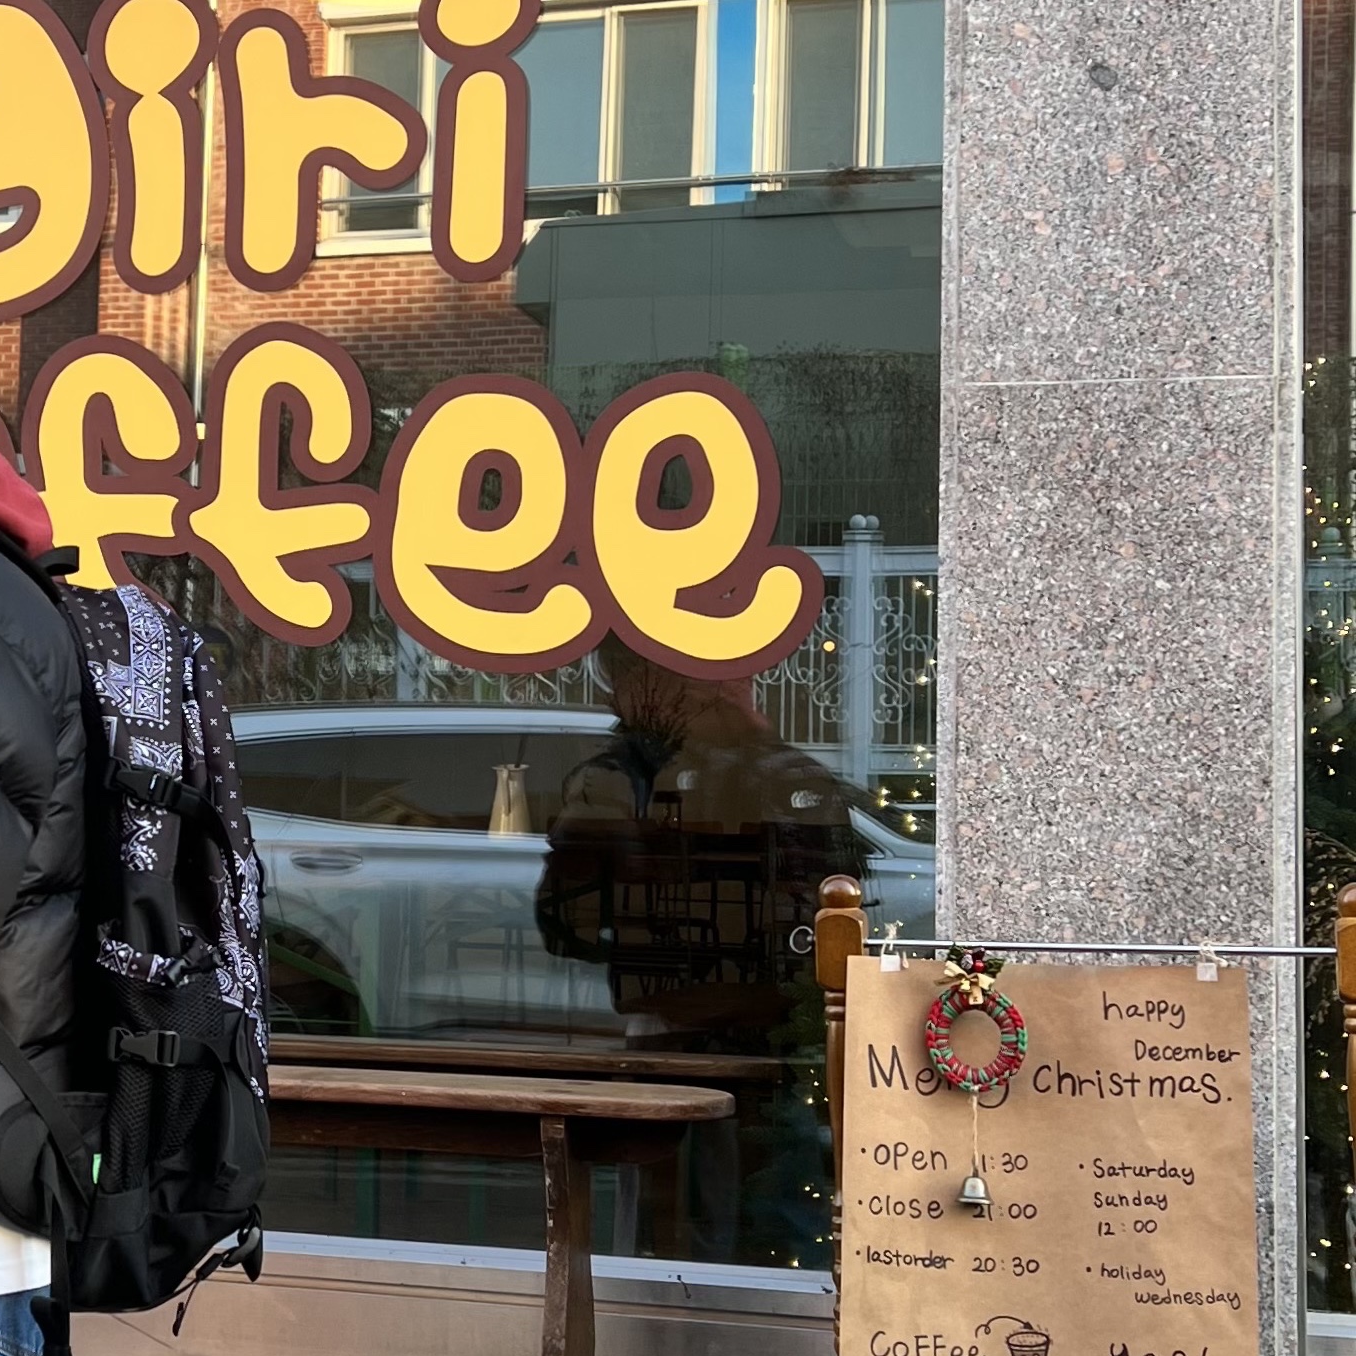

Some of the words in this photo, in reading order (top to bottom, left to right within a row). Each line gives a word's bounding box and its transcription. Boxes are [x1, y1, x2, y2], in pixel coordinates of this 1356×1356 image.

[1102, 990, 1185, 1029] happy
[1134, 1039, 1241, 1063] December
[1093, 1157, 1195, 1185] Saturday
[1097, 1219, 1158, 1237] 12:00
[971, 1256, 1040, 1277] 20:30
[1100, 1262, 1167, 1286] holiday
[1134, 1288, 1242, 1311] wednesday
